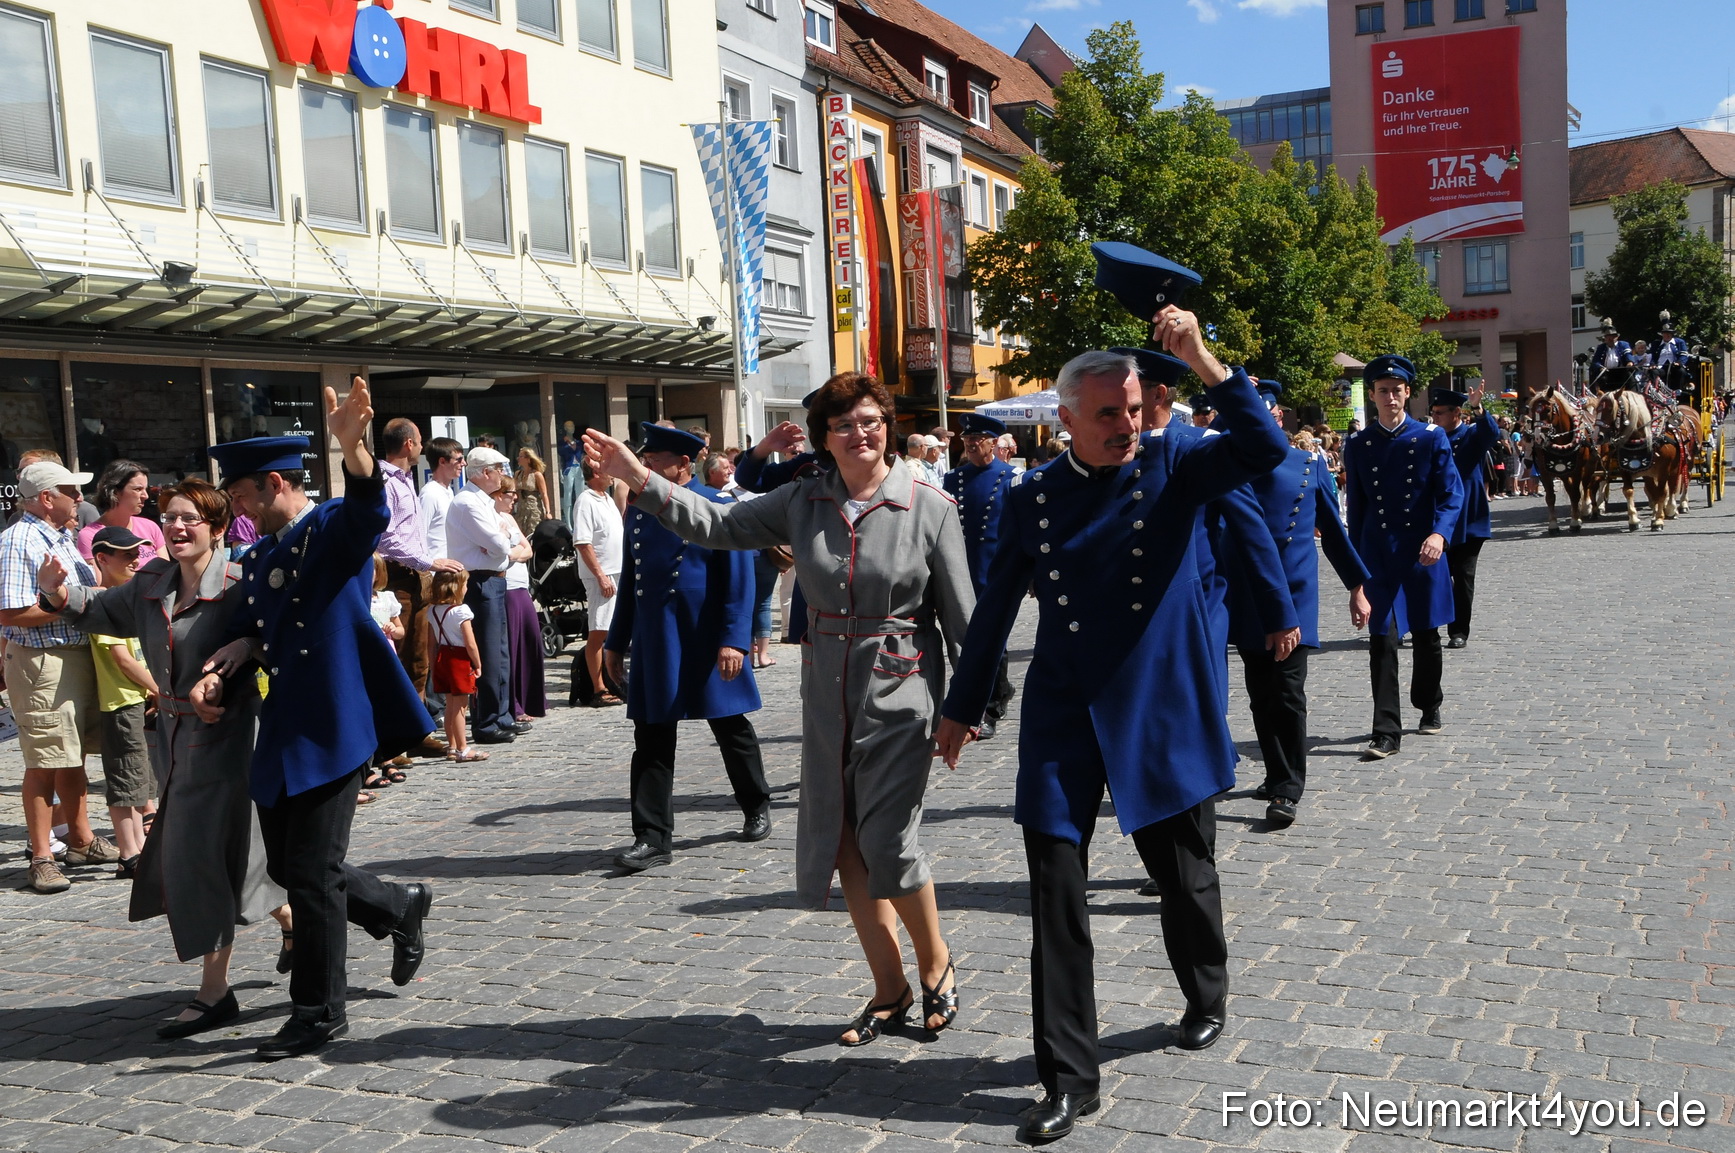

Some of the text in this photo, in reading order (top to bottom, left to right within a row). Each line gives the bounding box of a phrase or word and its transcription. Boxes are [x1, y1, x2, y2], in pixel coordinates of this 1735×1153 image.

[1383, 87, 1435, 106] Danke
[1382, 106, 1470, 123] für Ihr Vertrauen
[1383, 120, 1462, 137] und Ihre Treue.
[1427, 154, 1477, 177] 175
[829, 97, 851, 282] BÄCKEREI
[1429, 174, 1477, 190] JAHRE
[1429, 190, 1510, 202] Sparkasse Neumarkt-Parsberg
[837, 290, 851, 304] caf
[984, 408, 1025, 417] Winkler Bräu
